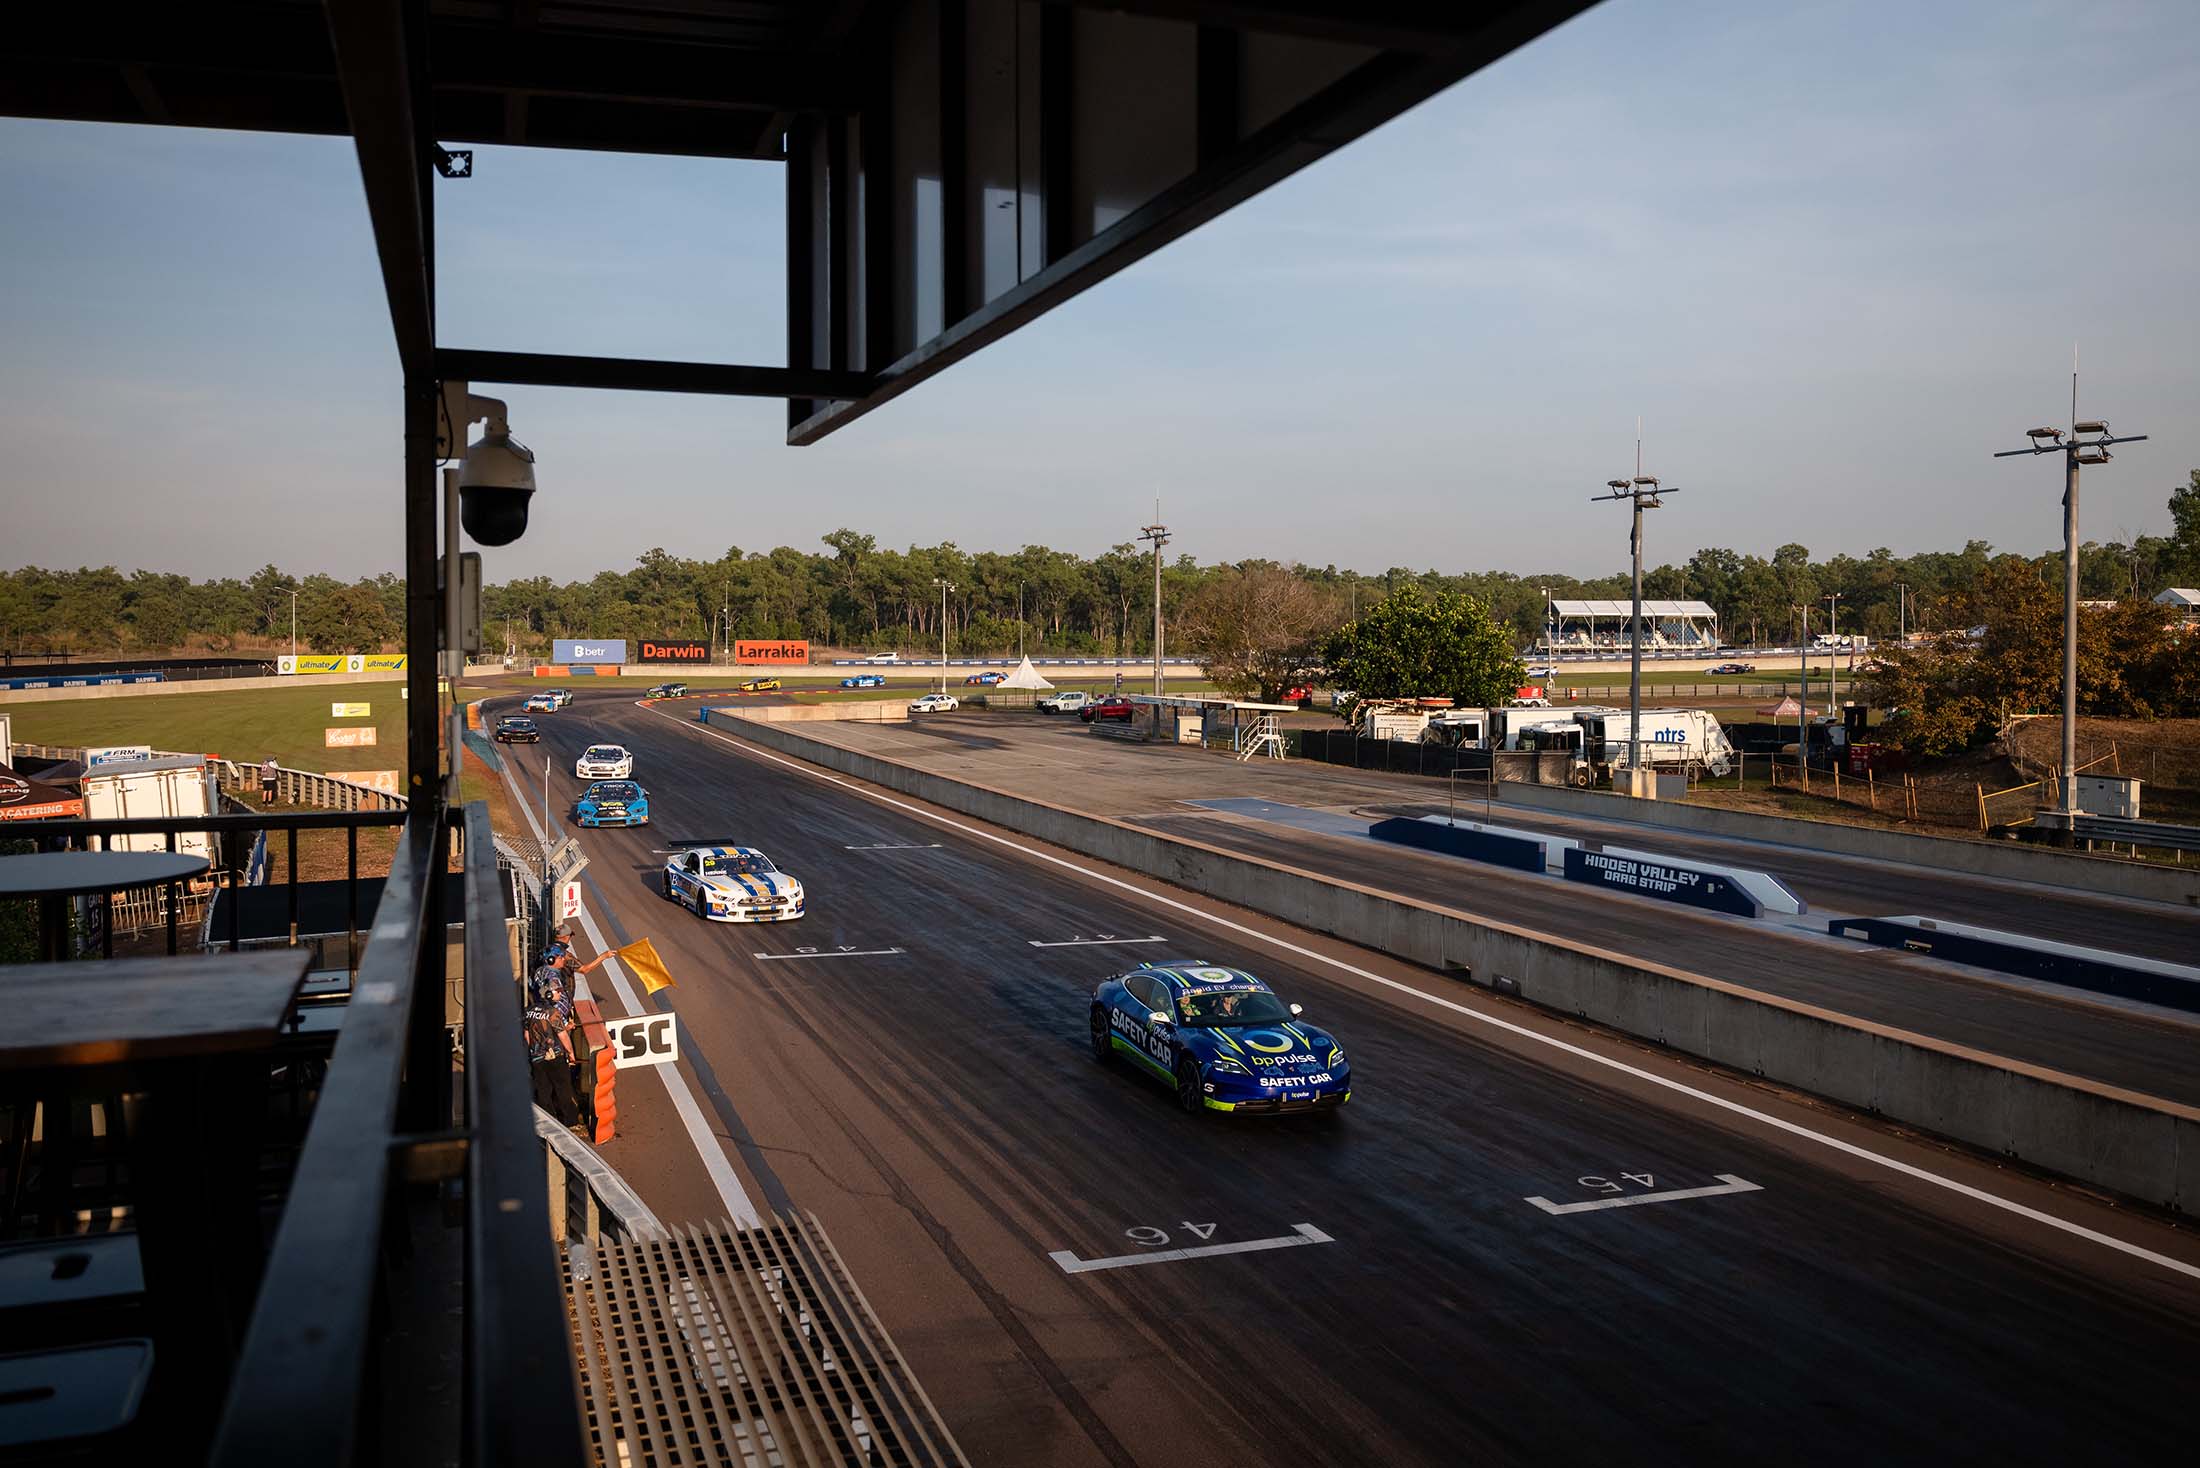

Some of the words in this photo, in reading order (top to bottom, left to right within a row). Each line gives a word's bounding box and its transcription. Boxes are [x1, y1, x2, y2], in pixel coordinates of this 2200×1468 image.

[585, 648, 605, 656] betr
[643, 644, 705, 658] Darwin
[739, 645, 805, 658] Larrakia
[1655, 727, 1686, 743] ntrs
[7, 804, 63, 816] CATERING
[1584, 854, 1638, 875] HIDDEN
[1640, 864, 1700, 886] VALLEY
[1604, 870, 1638, 886] DRAG
[1639, 877, 1677, 893] STRIP
[564, 900, 578, 908] FIRE
[1182, 985, 1212, 996] Rapid
[608, 1019, 672, 1060] SC
[1111, 1007, 1148, 1048] SAFETY
[1150, 1036, 1172, 1068] CAR
[1251, 1055, 1274, 1067] bp
[1274, 1053, 1317, 1066] pulse
[1259, 1077, 1306, 1087] SAFETY
[1308, 1072, 1333, 1084] CAR
[1578, 1171, 1654, 1193] 45
[1125, 1221, 1217, 1246] 46
